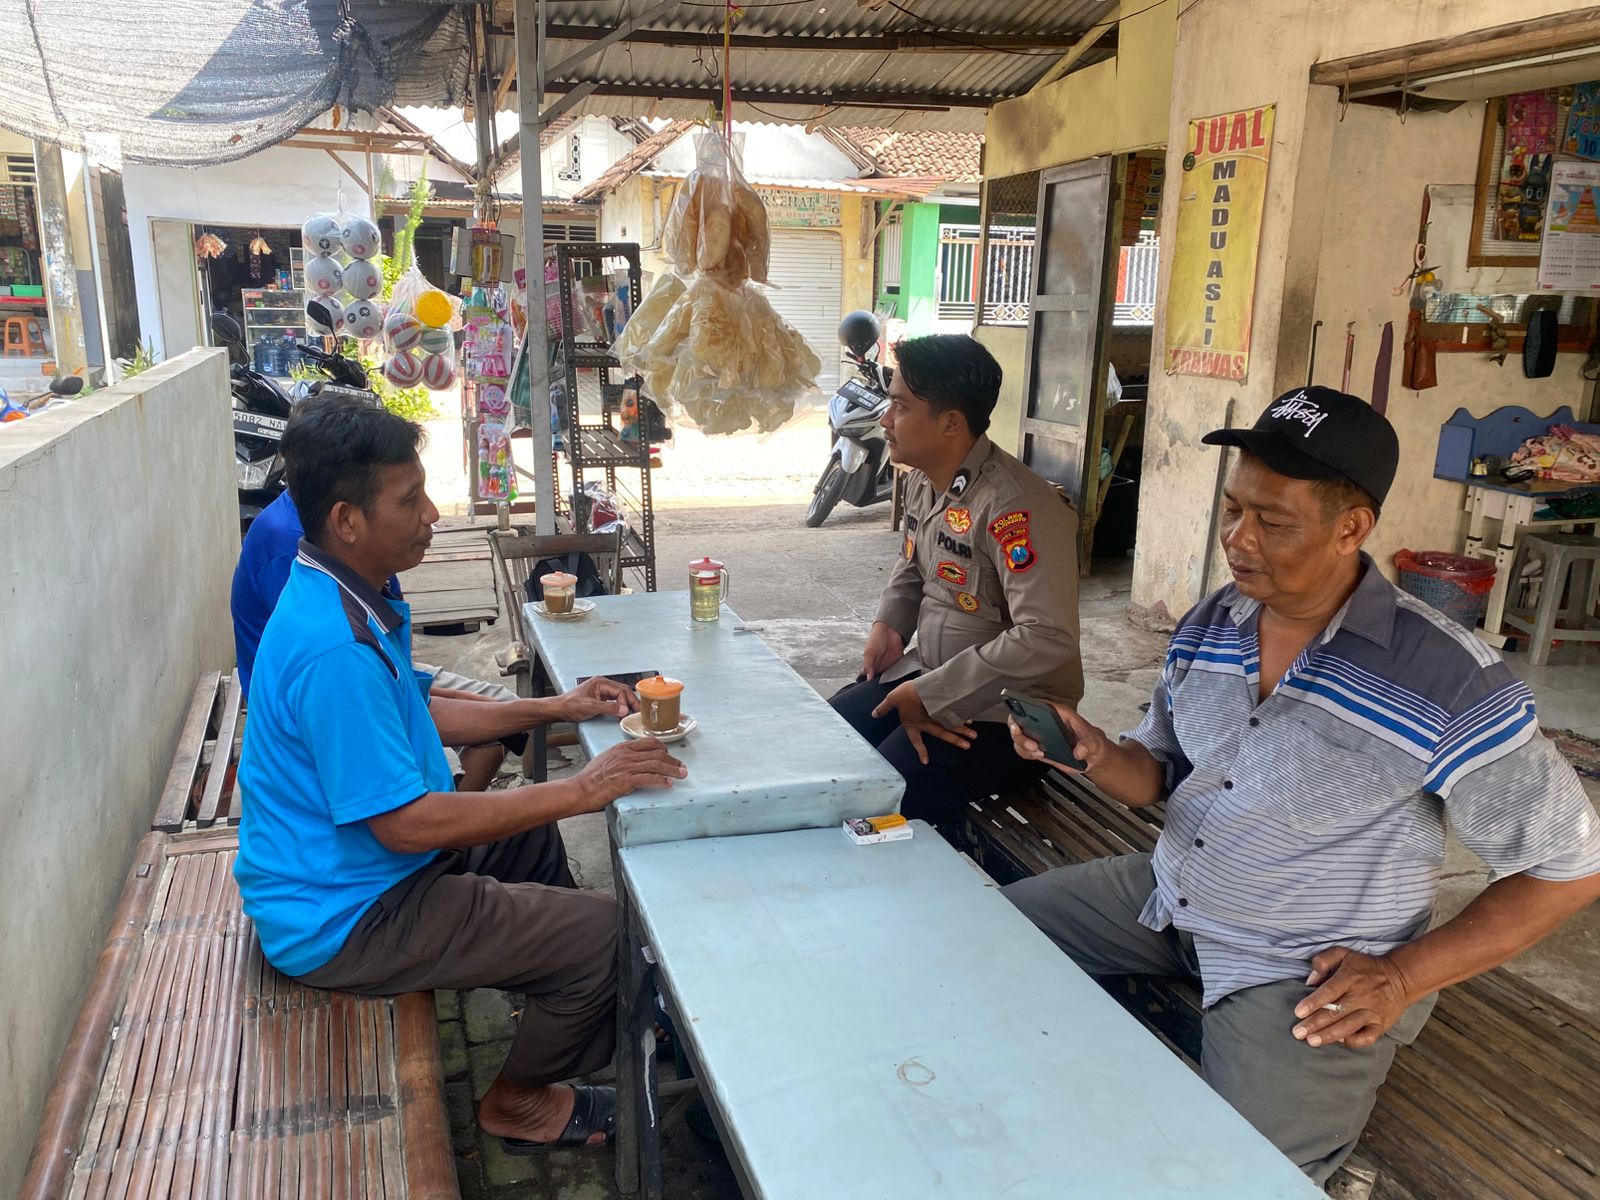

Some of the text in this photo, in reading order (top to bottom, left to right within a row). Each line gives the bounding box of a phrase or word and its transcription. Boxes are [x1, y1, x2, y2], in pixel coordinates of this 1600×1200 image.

[1194, 108, 1267, 156] JUAL
[1584, 138, 1598, 155] 10
[1203, 159, 1236, 346] MADU ASLI
[1169, 348, 1246, 380] TRAWAS
[234, 412, 262, 426] 5082
[938, 531, 972, 558] POLRI
